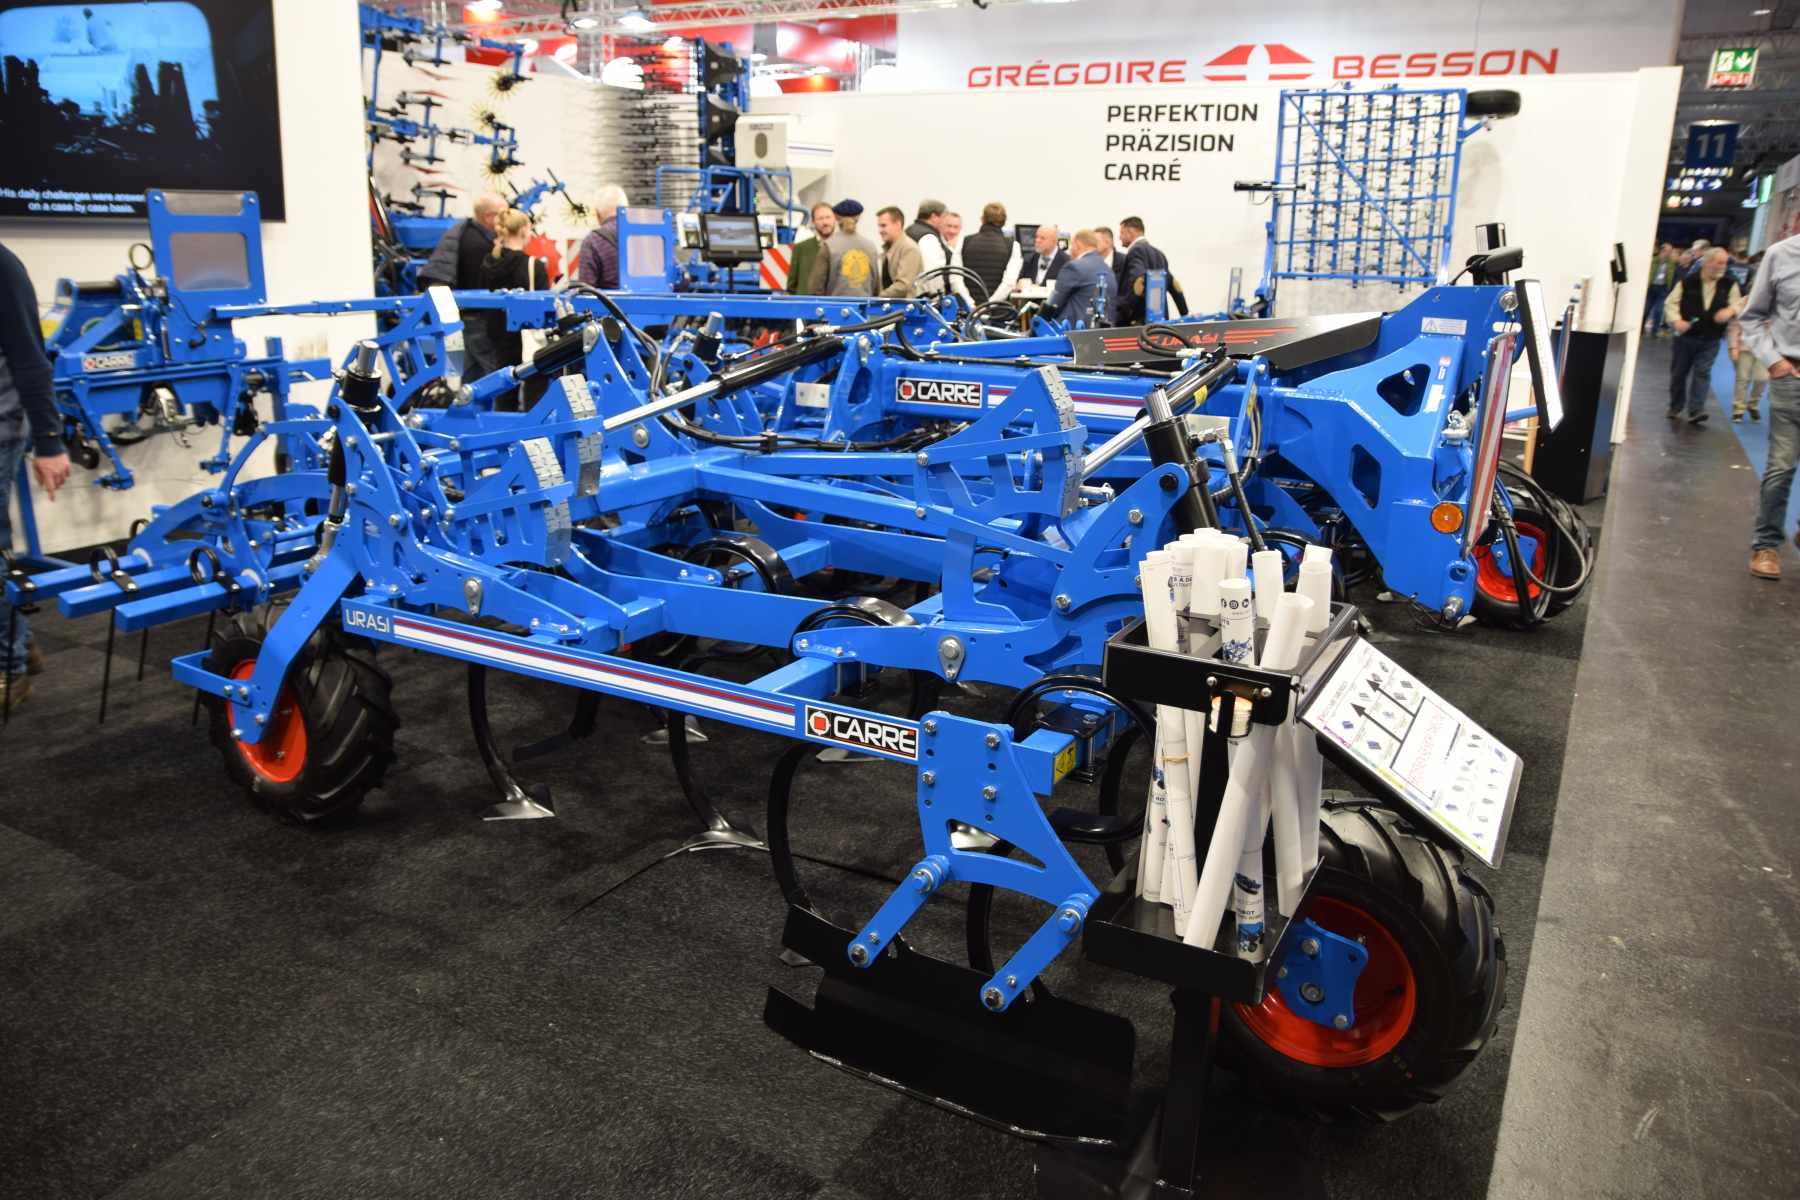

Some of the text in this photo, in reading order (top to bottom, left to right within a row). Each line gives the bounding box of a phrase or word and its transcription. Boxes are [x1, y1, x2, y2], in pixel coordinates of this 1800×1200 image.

[968, 48, 1560, 88] GRÉGOIRE BESSON
[1107, 104, 1258, 122] PERFEKTION
[1105, 128, 1234, 152] PRÄZISION
[1696, 133, 1726, 159] 11
[1104, 158, 1181, 181] CARRÉ
[17, 188, 40, 201] daily
[41, 190, 91, 202] challenges
[91, 192, 114, 202] were
[28, 202, 41, 211] on
[51, 203, 73, 212] case
[74, 202, 86, 214] by
[87, 204, 109, 213] case
[345, 608, 391, 634] URASI
